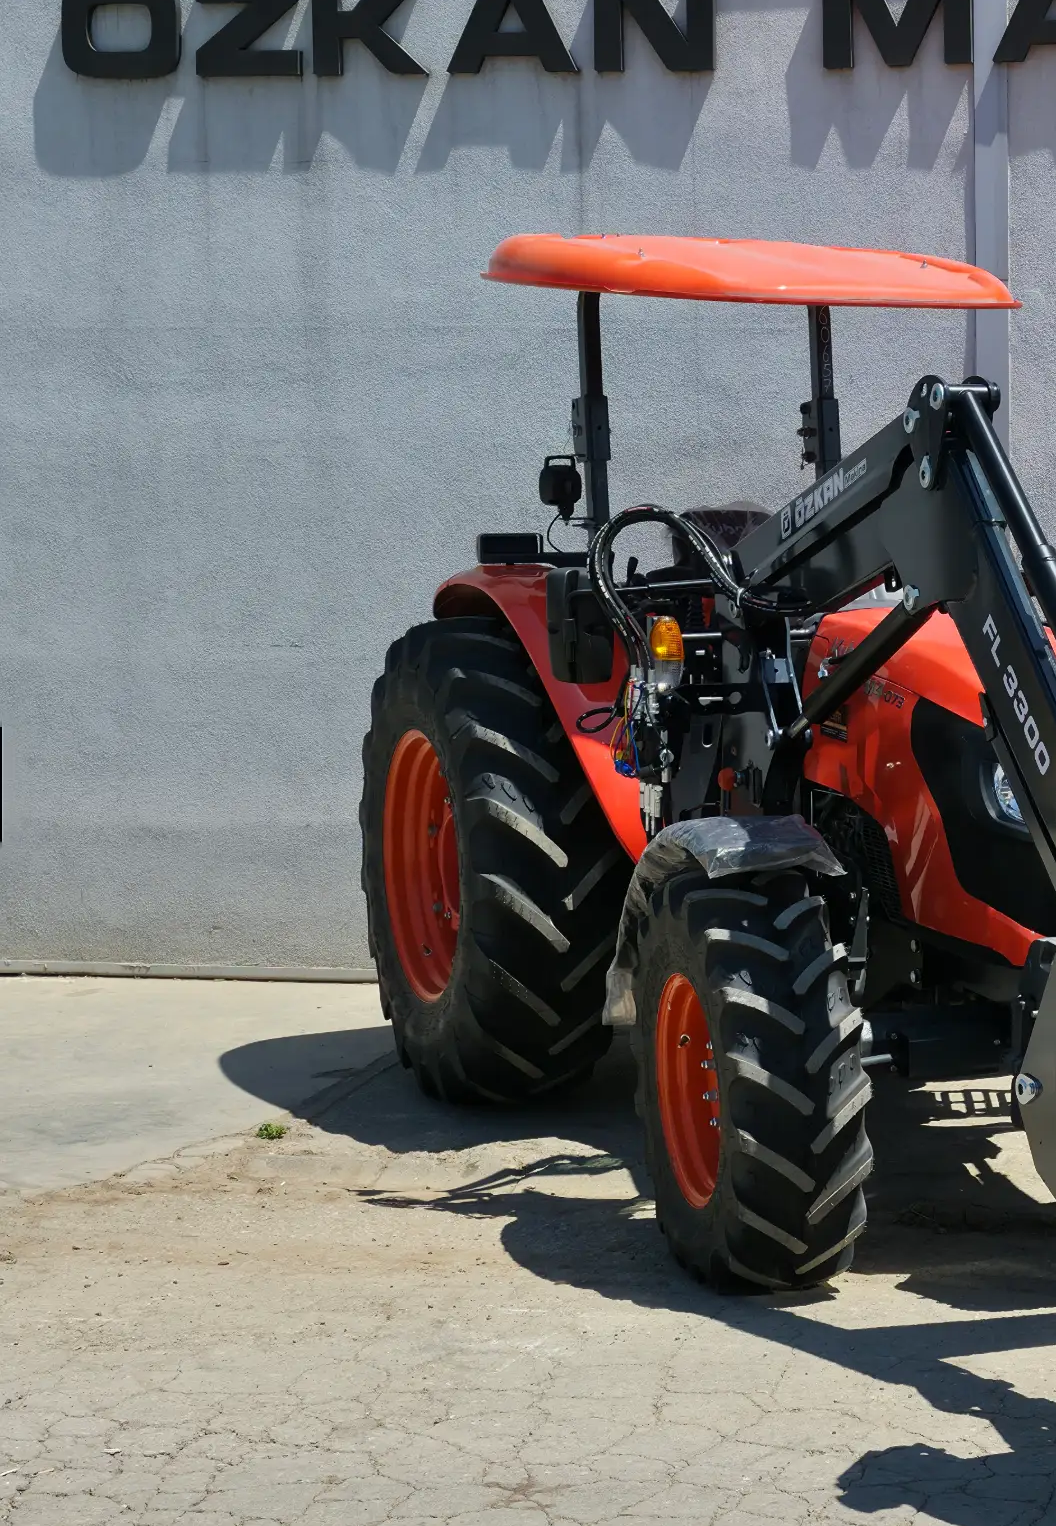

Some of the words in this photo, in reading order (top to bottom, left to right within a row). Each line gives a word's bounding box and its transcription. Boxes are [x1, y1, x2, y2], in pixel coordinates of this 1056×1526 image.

[795, 467, 844, 528] ÖZKAN
[983, 614, 1001, 668] FL
[1003, 664, 1051, 776] 3300
